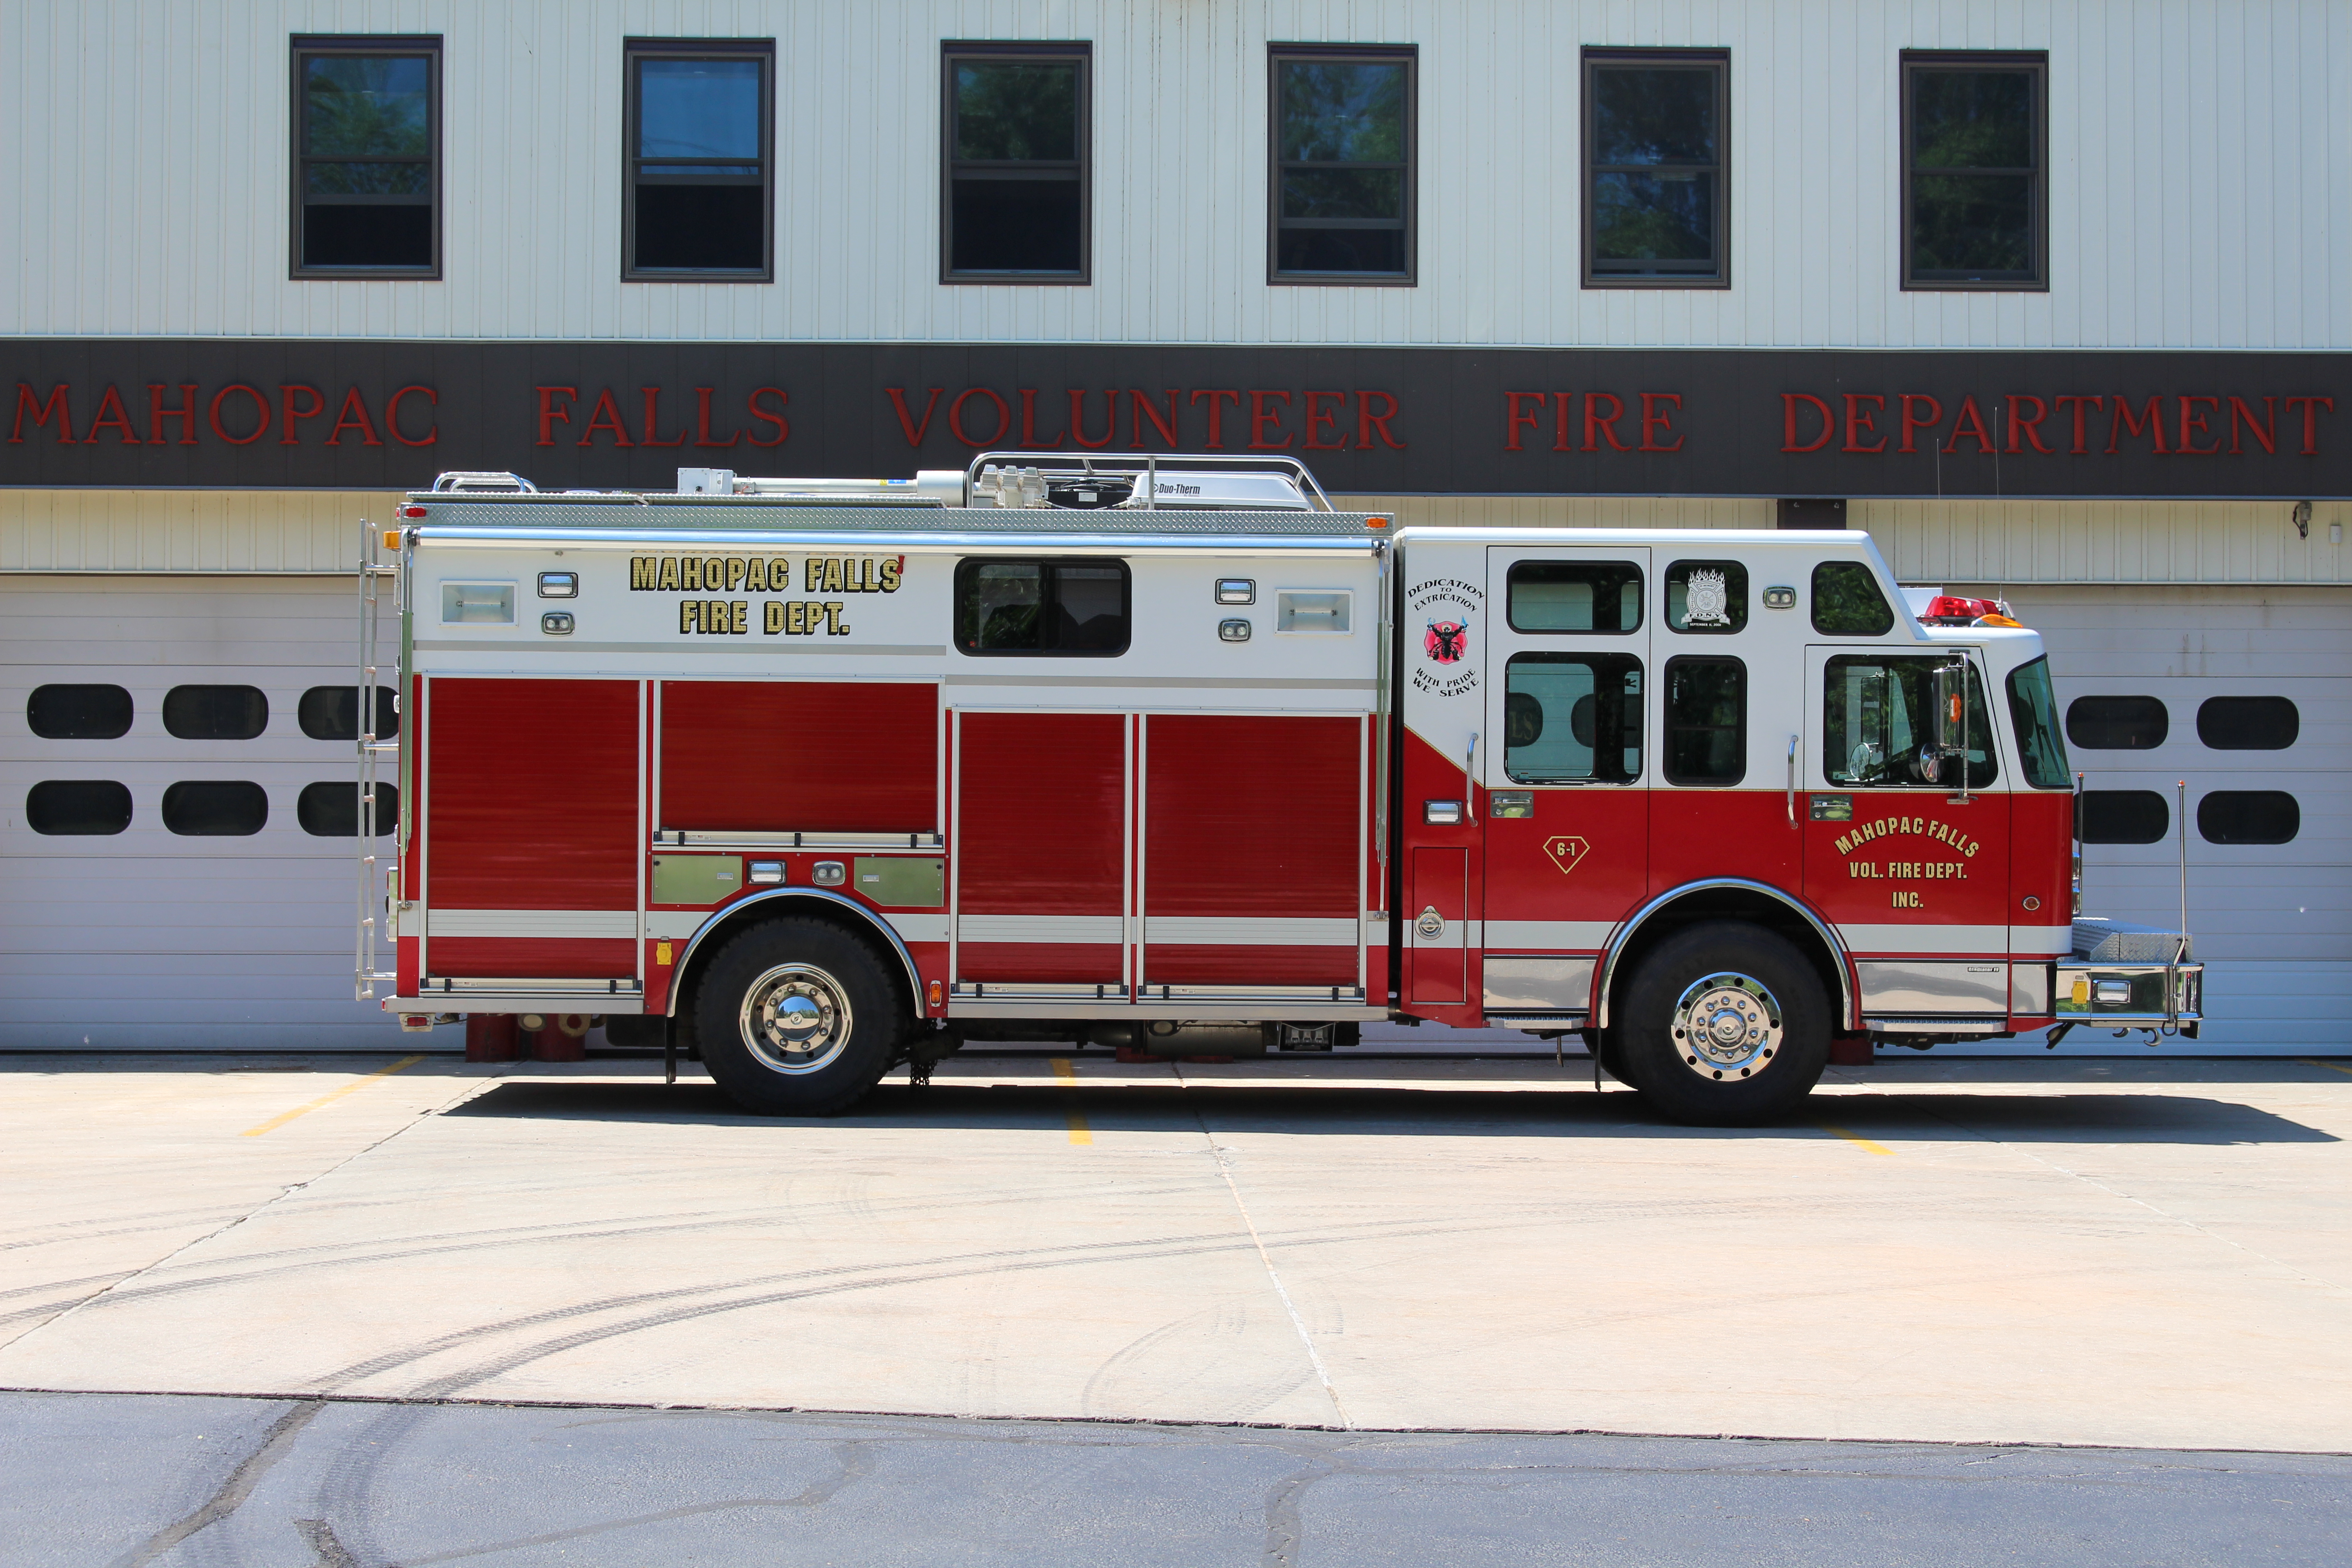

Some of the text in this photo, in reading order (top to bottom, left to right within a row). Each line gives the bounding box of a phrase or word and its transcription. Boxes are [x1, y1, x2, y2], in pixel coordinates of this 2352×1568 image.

[9, 383, 2334, 455] MAHOPAC FALLS VOLUNTEER FIRE DEPARTMENT
[1158, 483, 1200, 494] Duo-Therm
[630, 557, 901, 593] MAHOPAC FALLS
[1408, 578, 1485, 599] DEDICATION
[1414, 593, 1477, 612] EXTRICATION
[680, 601, 850, 636] FIRE DEPT.
[1413, 676, 1479, 697] WE SERVE
[1416, 667, 1476, 687] WITH PRIDE
[1834, 817, 1980, 858] MAHOPAC FALLS
[1557, 843, 1575, 857] 6-1
[1850, 862, 1967, 879] VOL. FIRE DEPT.
[1893, 892, 1924, 908] INC.
